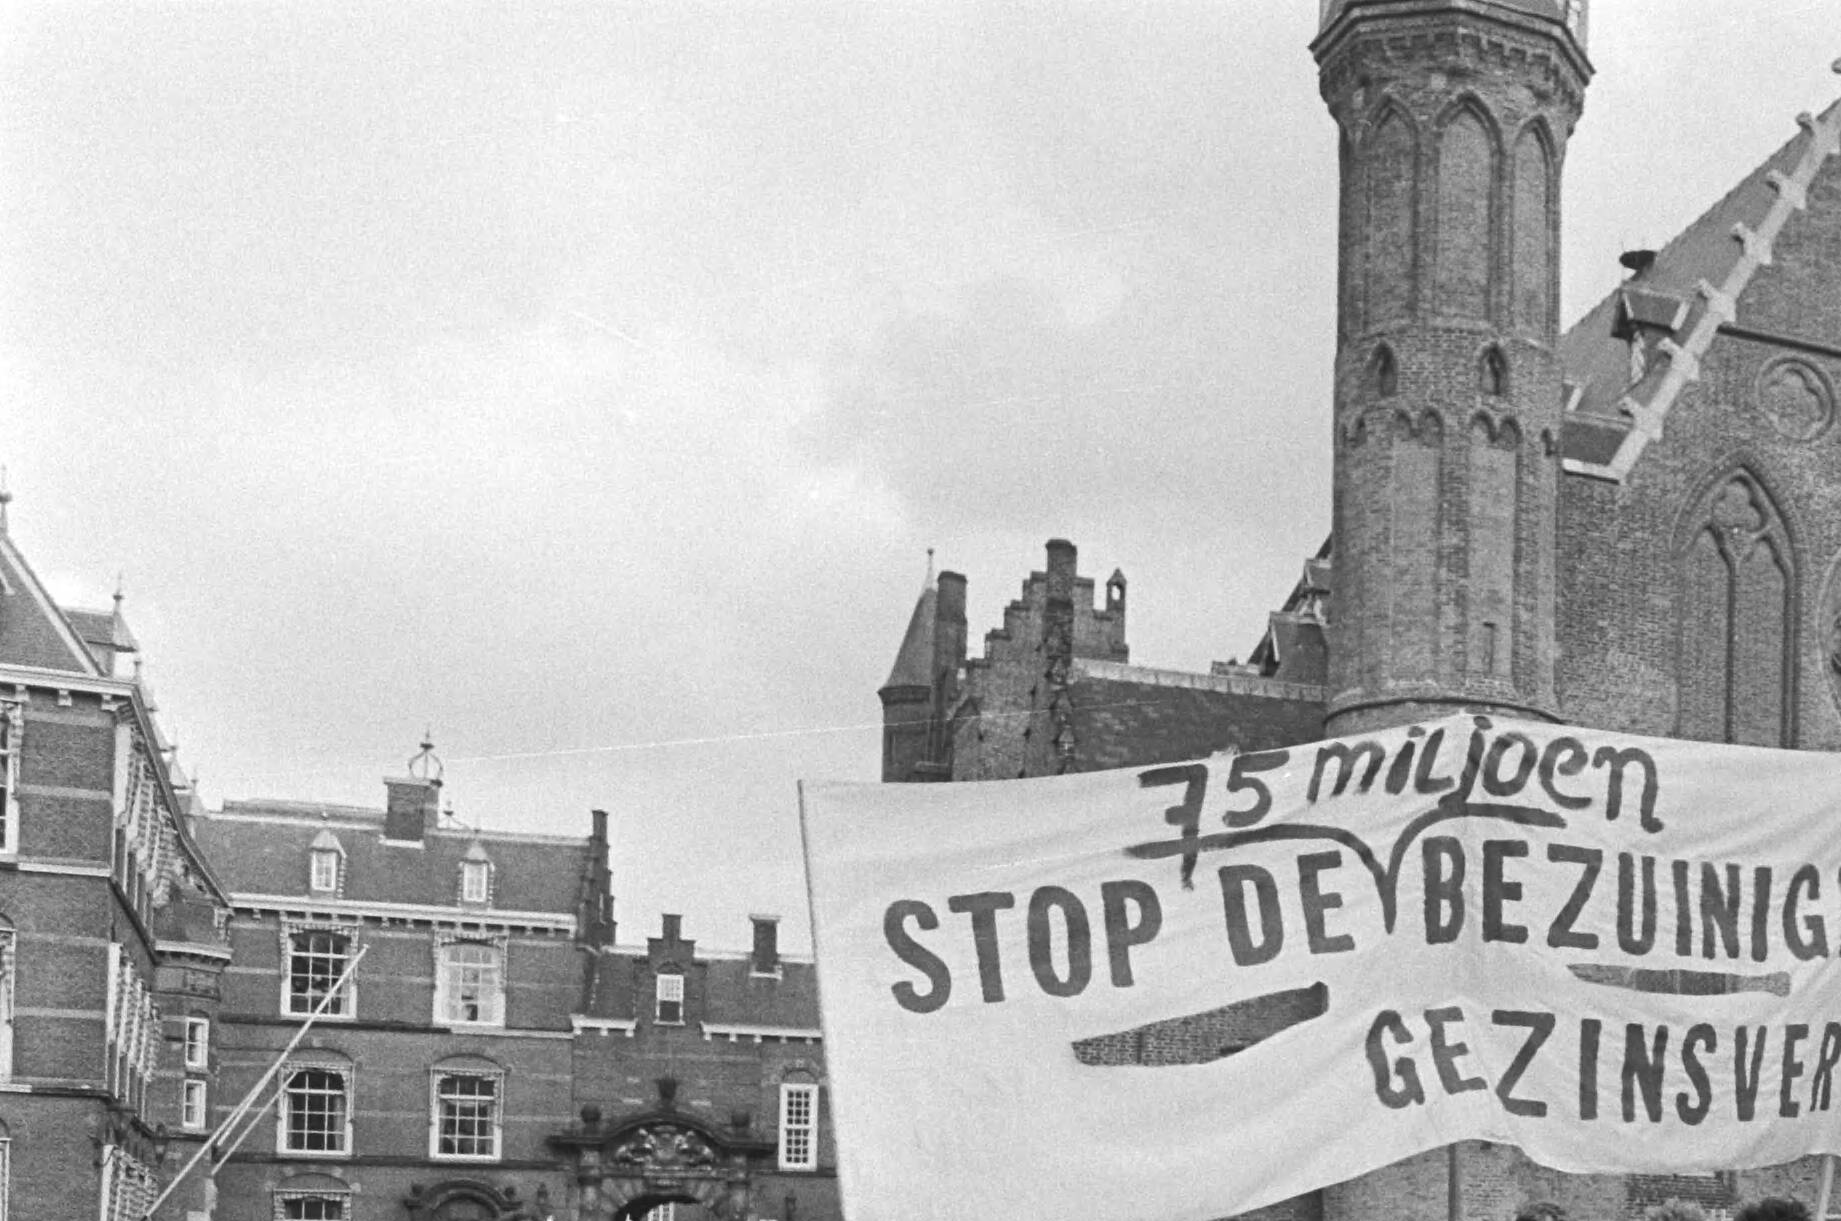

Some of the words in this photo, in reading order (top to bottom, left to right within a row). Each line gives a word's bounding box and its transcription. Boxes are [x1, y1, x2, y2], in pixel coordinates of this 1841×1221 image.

[1137, 750, 1290, 890] 75
[883, 879, 1163, 1013] STOP
[1218, 850, 1356, 968] DE
